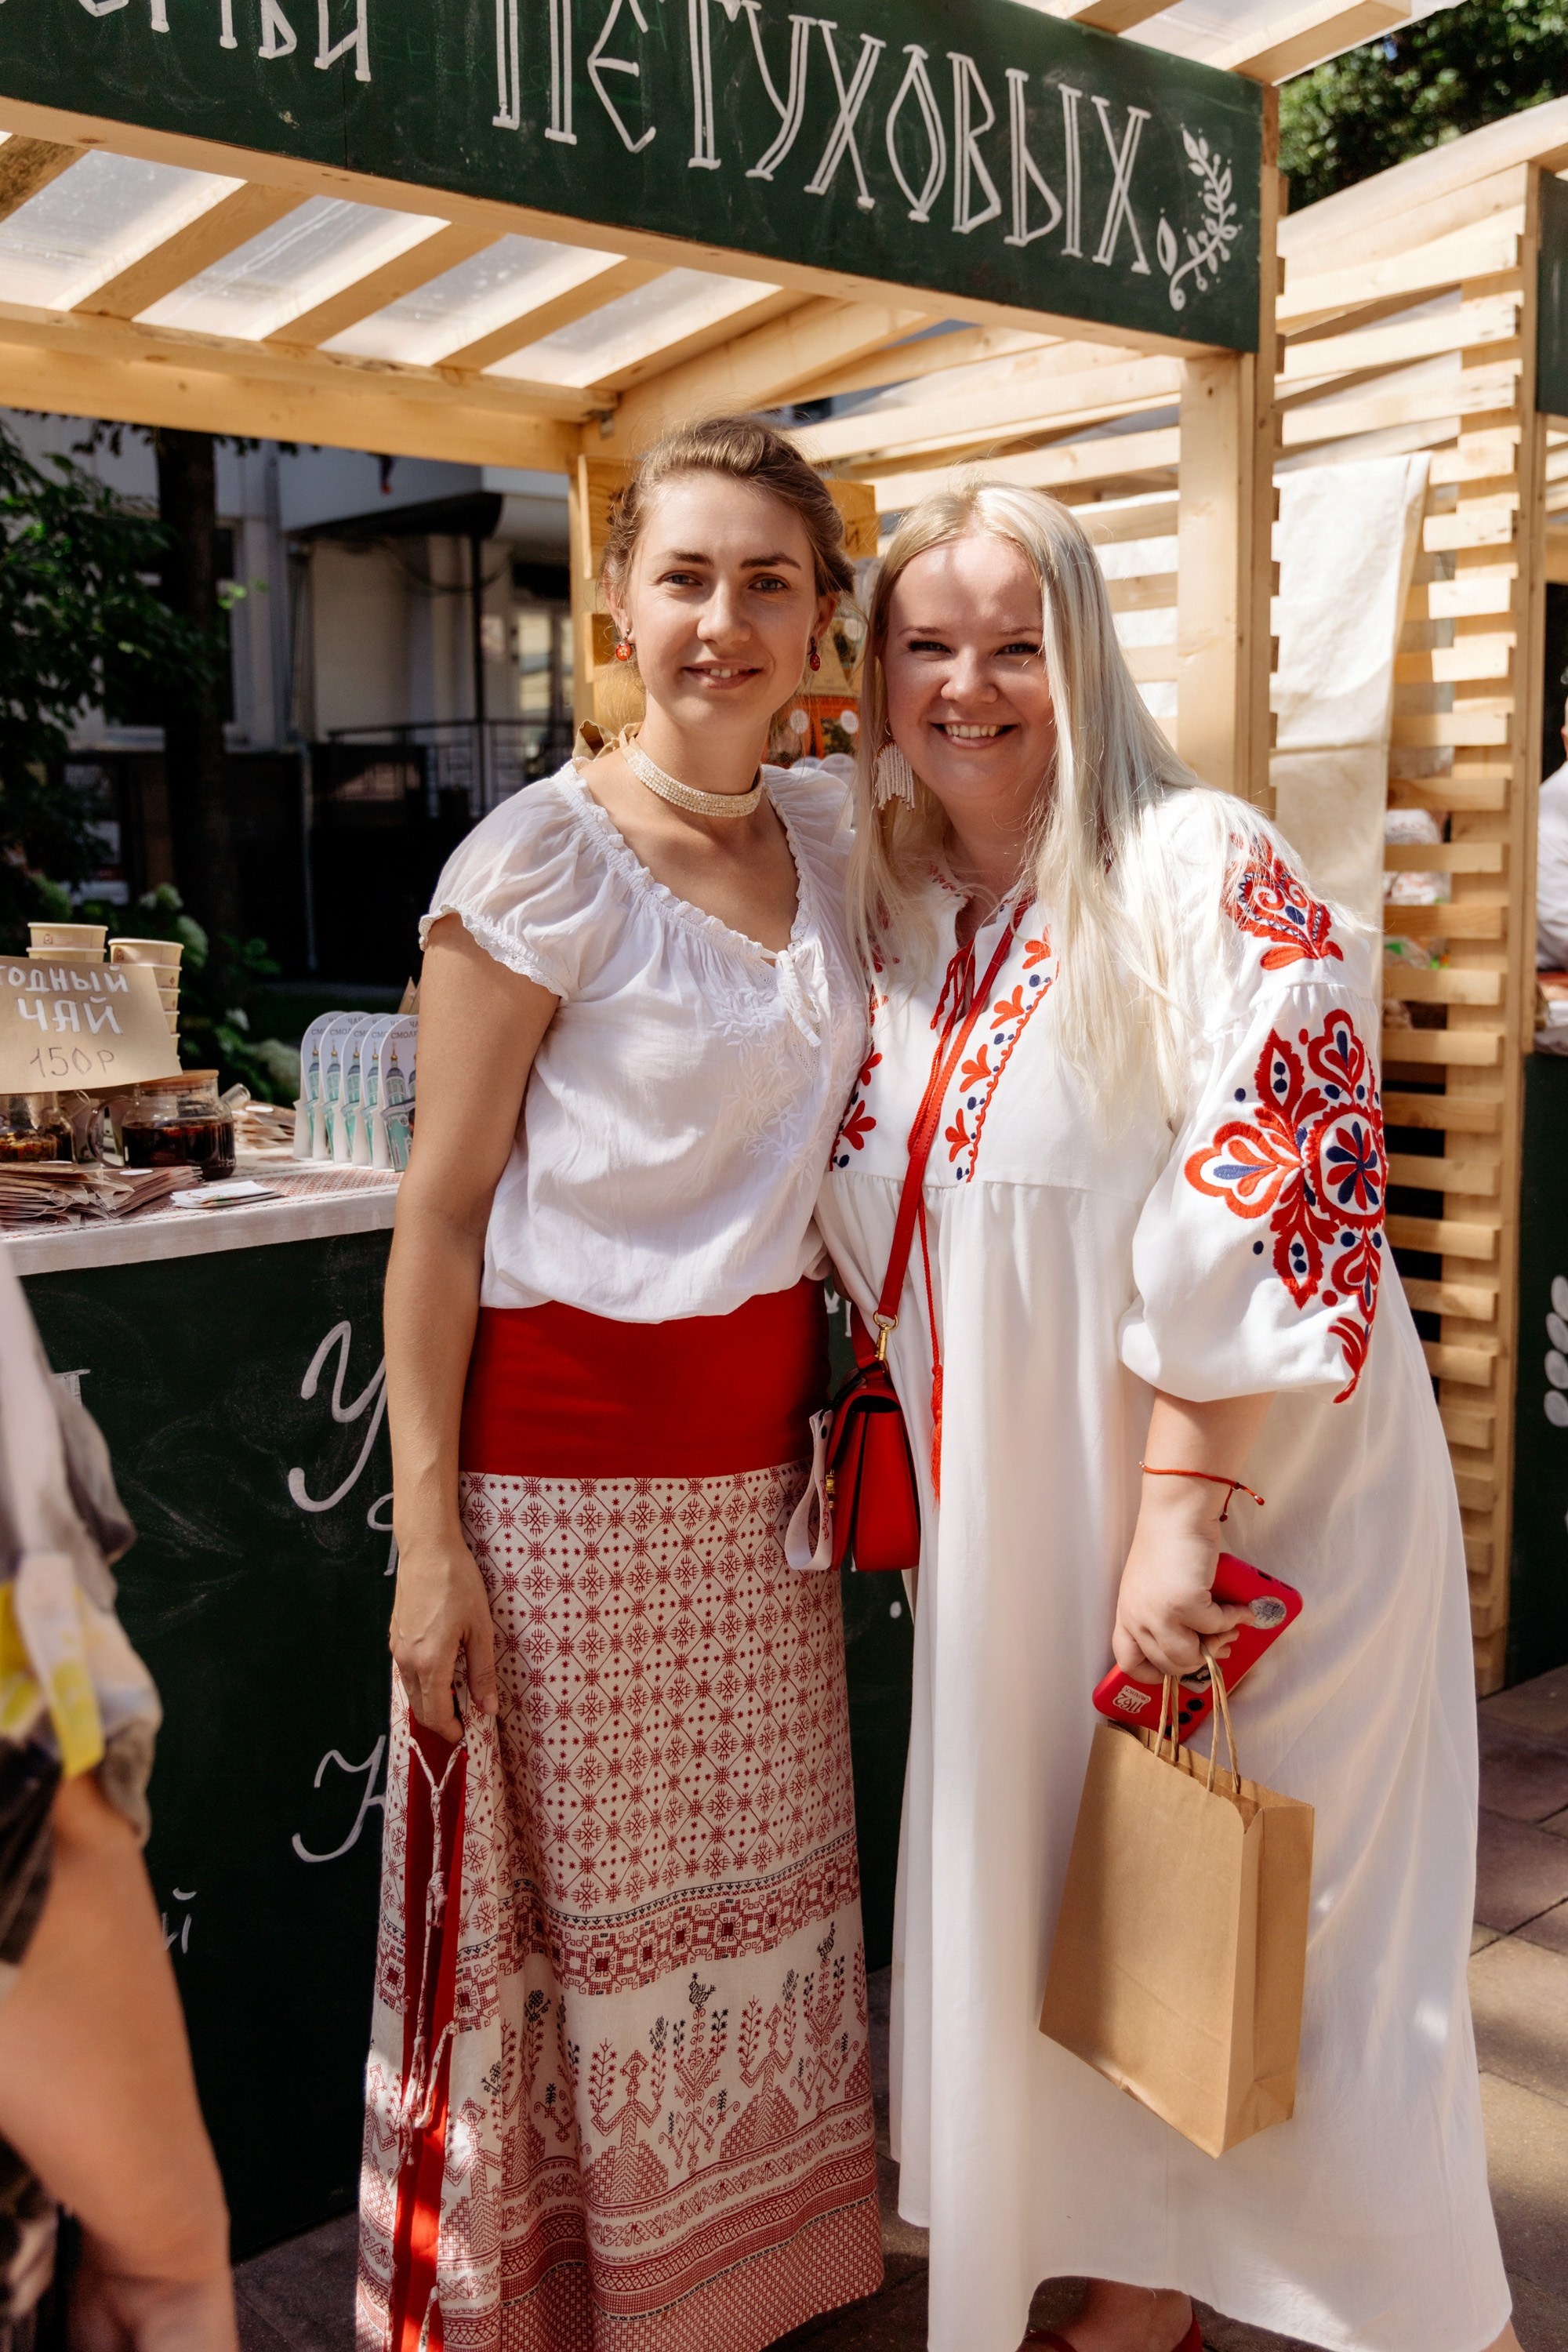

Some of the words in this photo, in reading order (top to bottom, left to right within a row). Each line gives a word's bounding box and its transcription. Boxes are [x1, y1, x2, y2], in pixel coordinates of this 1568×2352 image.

[492, 0, 1151, 275] ПЕТУХОВЫХ
[16, 996, 123, 1035] ЧАЙ
[1114, 1693, 1143, 1713] 1162
